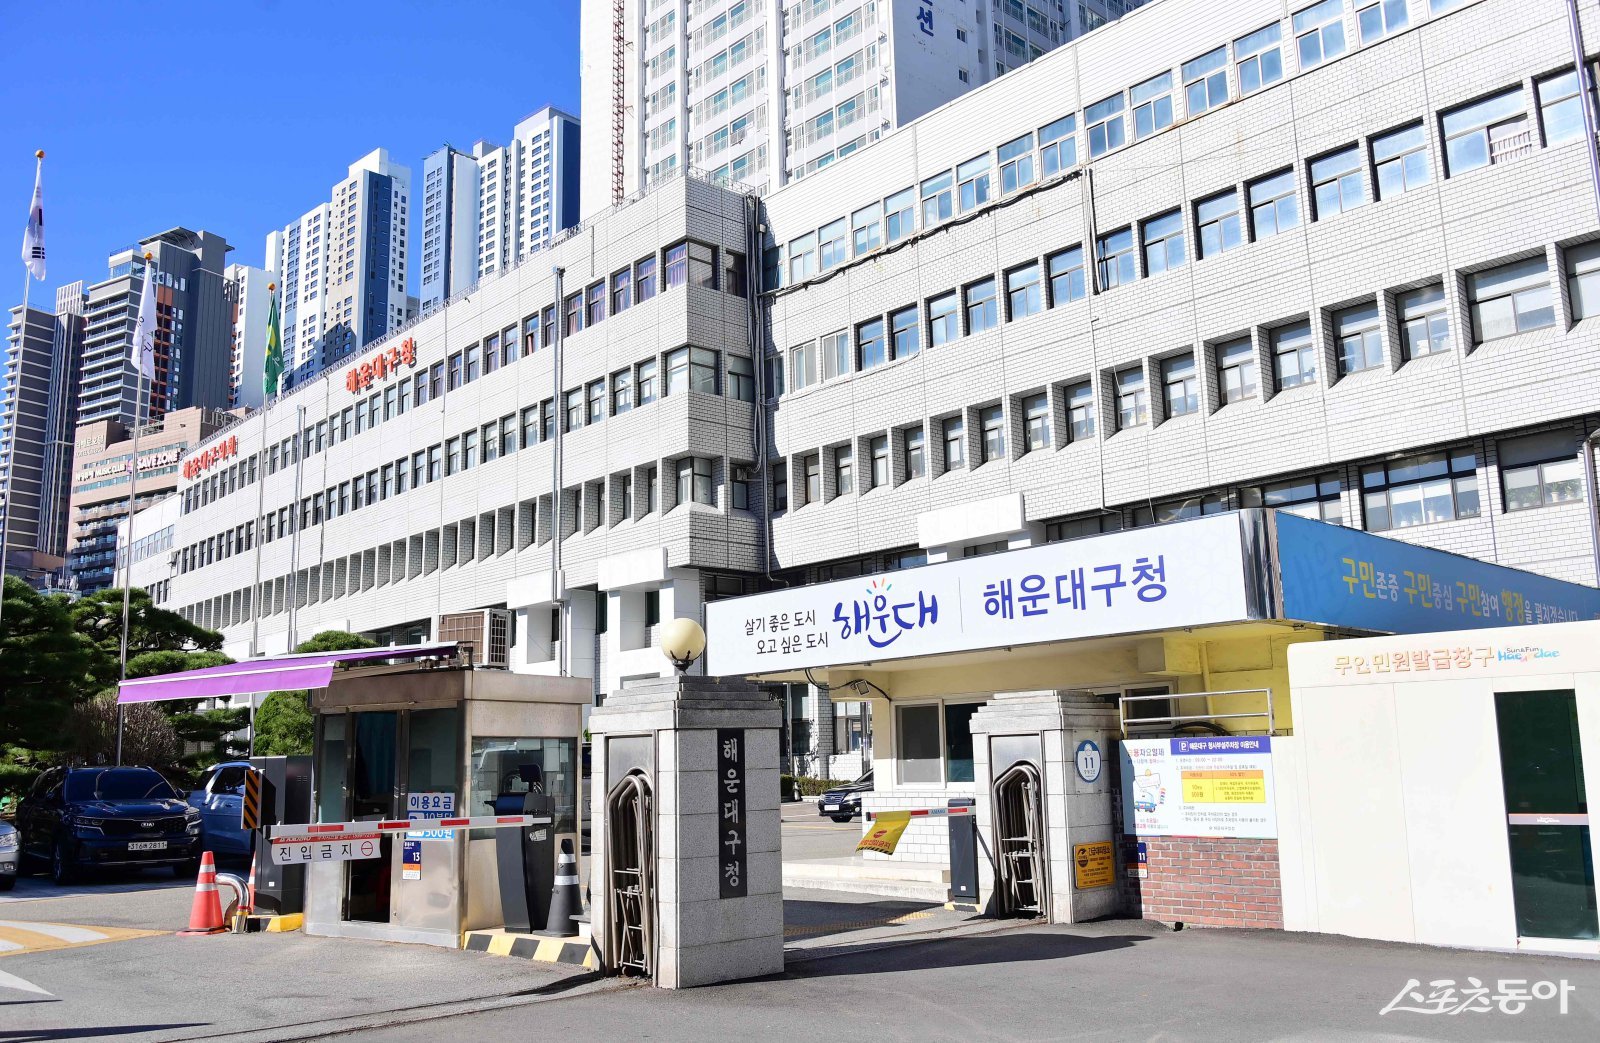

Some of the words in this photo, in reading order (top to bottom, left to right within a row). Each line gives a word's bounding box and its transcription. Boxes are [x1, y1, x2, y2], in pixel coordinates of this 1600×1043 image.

[917, 0, 934, 37] 선
[345, 337, 414, 393] 해운대구청
[137, 454, 156, 470] SAVE
[157, 450, 178, 465] ZONE
[182, 435, 237, 480] 해운대구의회
[983, 555, 1167, 620] 해운대구청
[1342, 557, 1399, 602] 구민존중
[1403, 570, 1453, 611] 구민중심
[1456, 581, 1500, 618] 구민참여
[1501, 588, 1533, 624] 행정을
[744, 617, 766, 636] 살기
[769, 613, 790, 633] 좋은
[794, 609, 816, 627] 도시
[832, 590, 939, 648] 해운대
[756, 639, 778, 655] 오고
[781, 634, 803, 655] 싶은
[806, 631, 829, 648] 도시
[1334, 646, 1495, 676] 무인민원발급창구
[1084, 757, 1094, 769] 11
[410, 796, 452, 809] 이용요금
[723, 737, 742, 887] 해운대구청
[279, 843, 353, 862] 진입금지
[412, 852, 421, 862] 13
